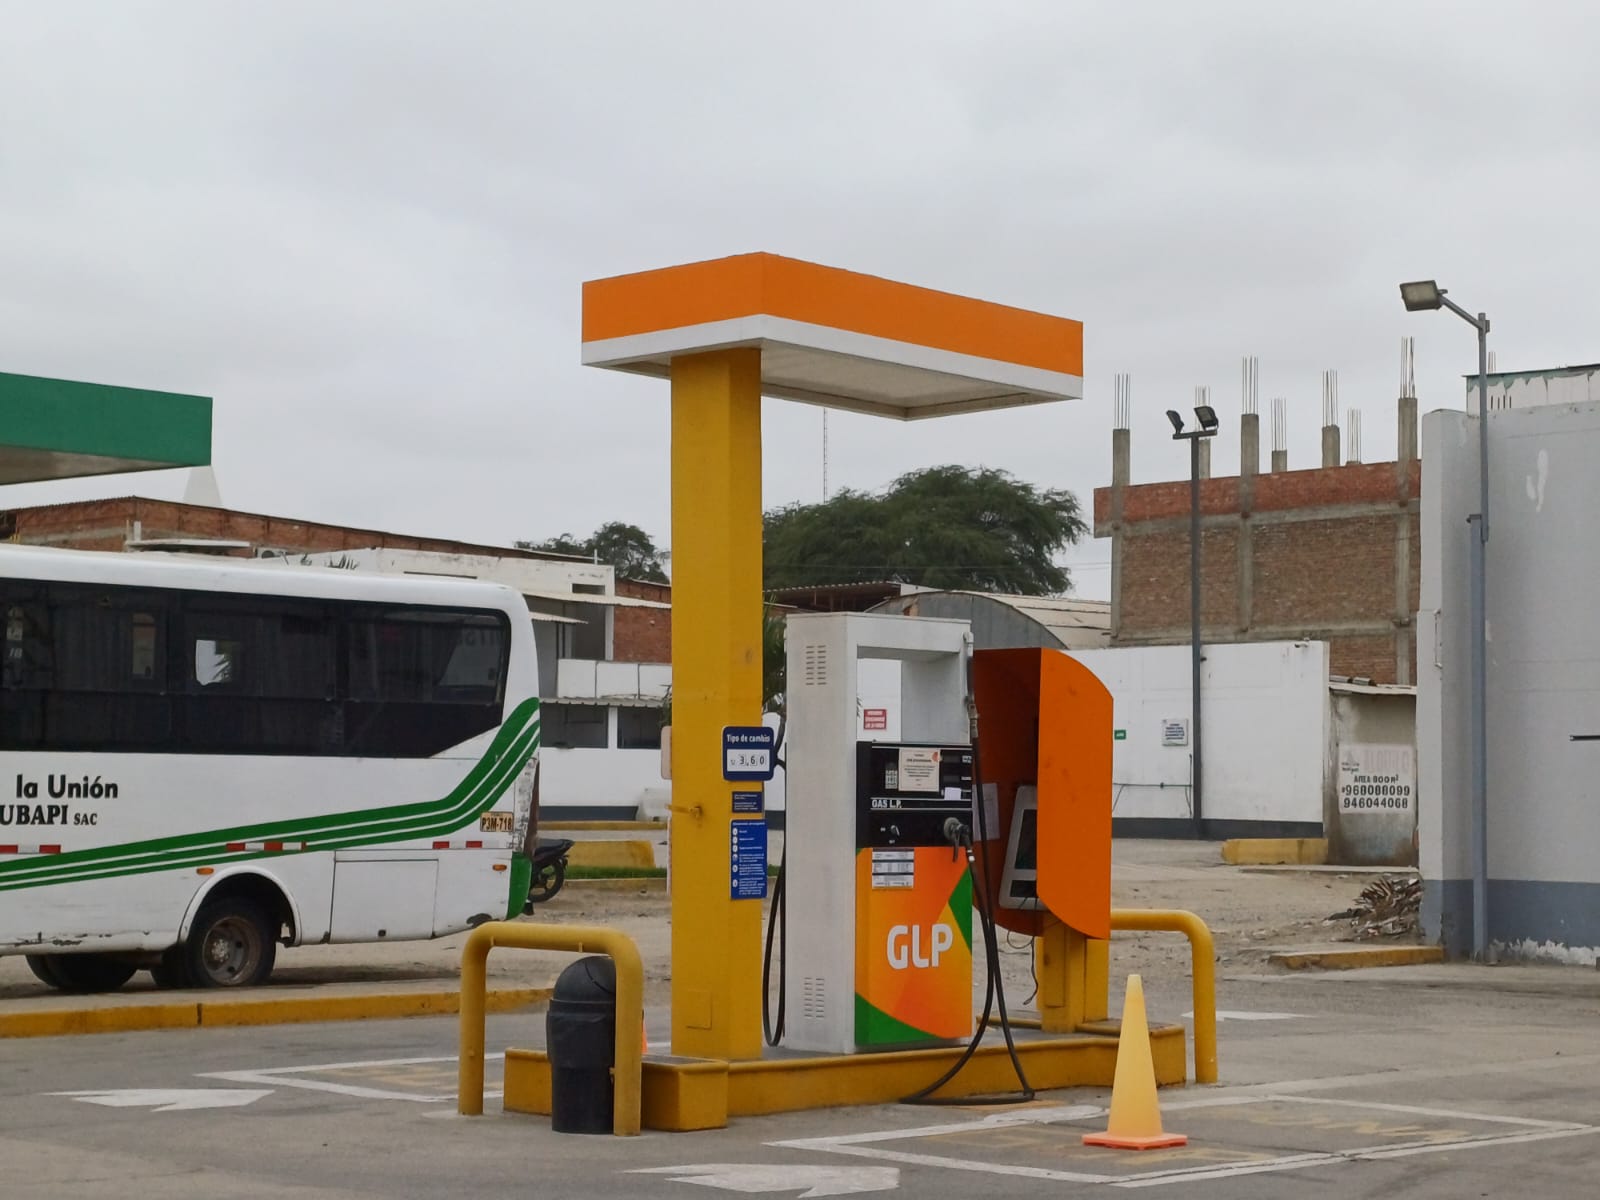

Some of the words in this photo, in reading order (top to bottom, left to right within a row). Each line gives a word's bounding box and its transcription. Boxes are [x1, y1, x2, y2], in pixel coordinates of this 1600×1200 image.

[726, 734, 740, 744] Tipo
[740, 734, 748, 743] de
[749, 733, 770, 743] cambio
[16, 774, 38, 799] la
[47, 774, 119, 799] Unión
[871, 799, 888, 808] GAS
[1343, 797, 1408, 809] 946044068
[0, 804, 69, 826] UBAPI
[73, 812, 98, 826] SAC
[886, 923, 954, 970] GLP
